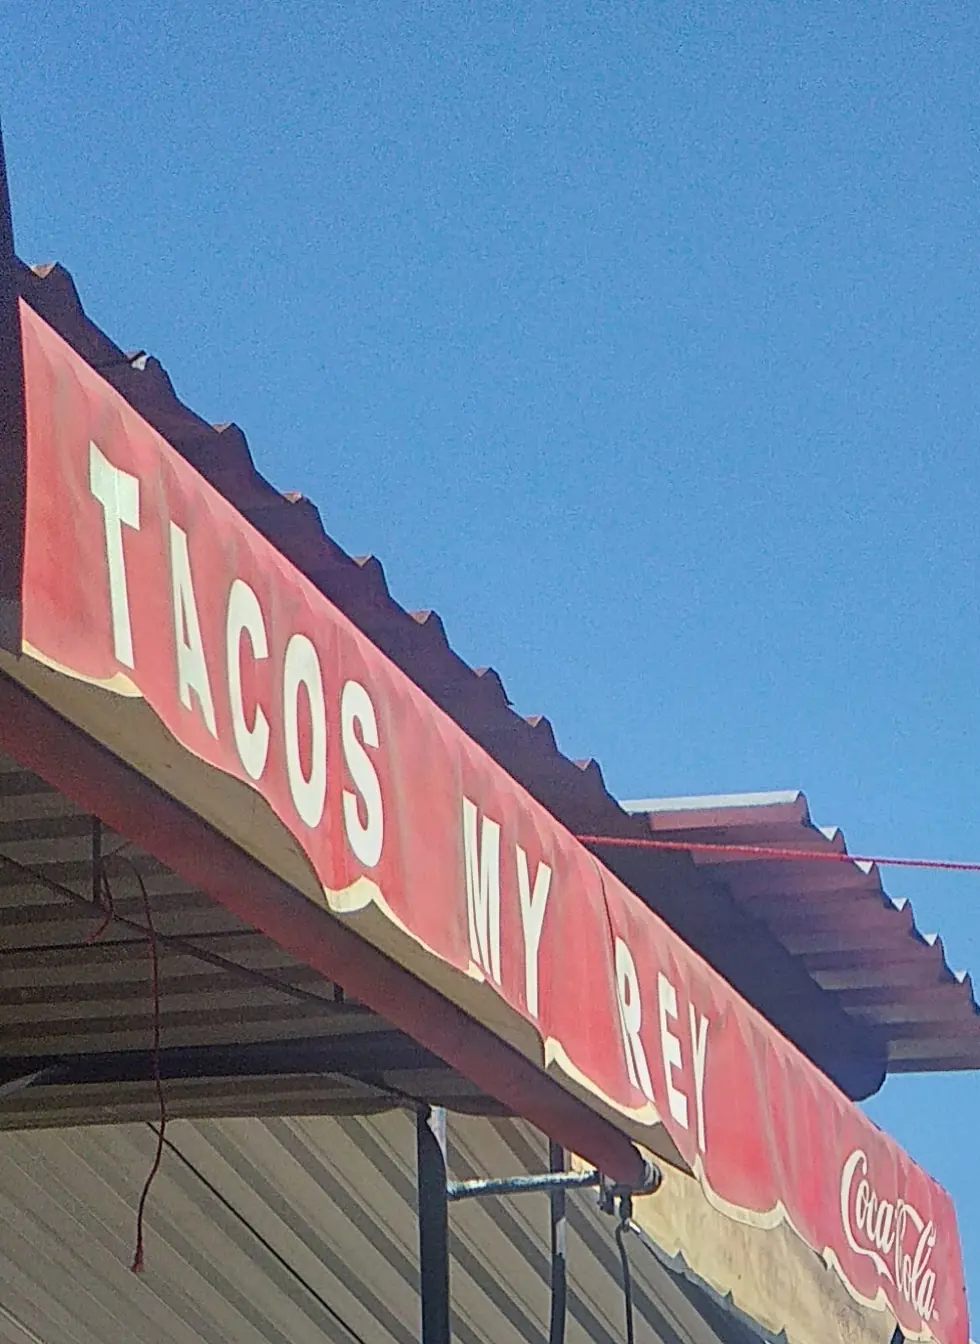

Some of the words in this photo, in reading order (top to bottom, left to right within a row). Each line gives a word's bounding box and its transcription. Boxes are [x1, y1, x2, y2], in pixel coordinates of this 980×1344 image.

[89, 441, 385, 868] TACOS
[462, 794, 552, 1018] MY
[615, 936, 710, 1153] REY
